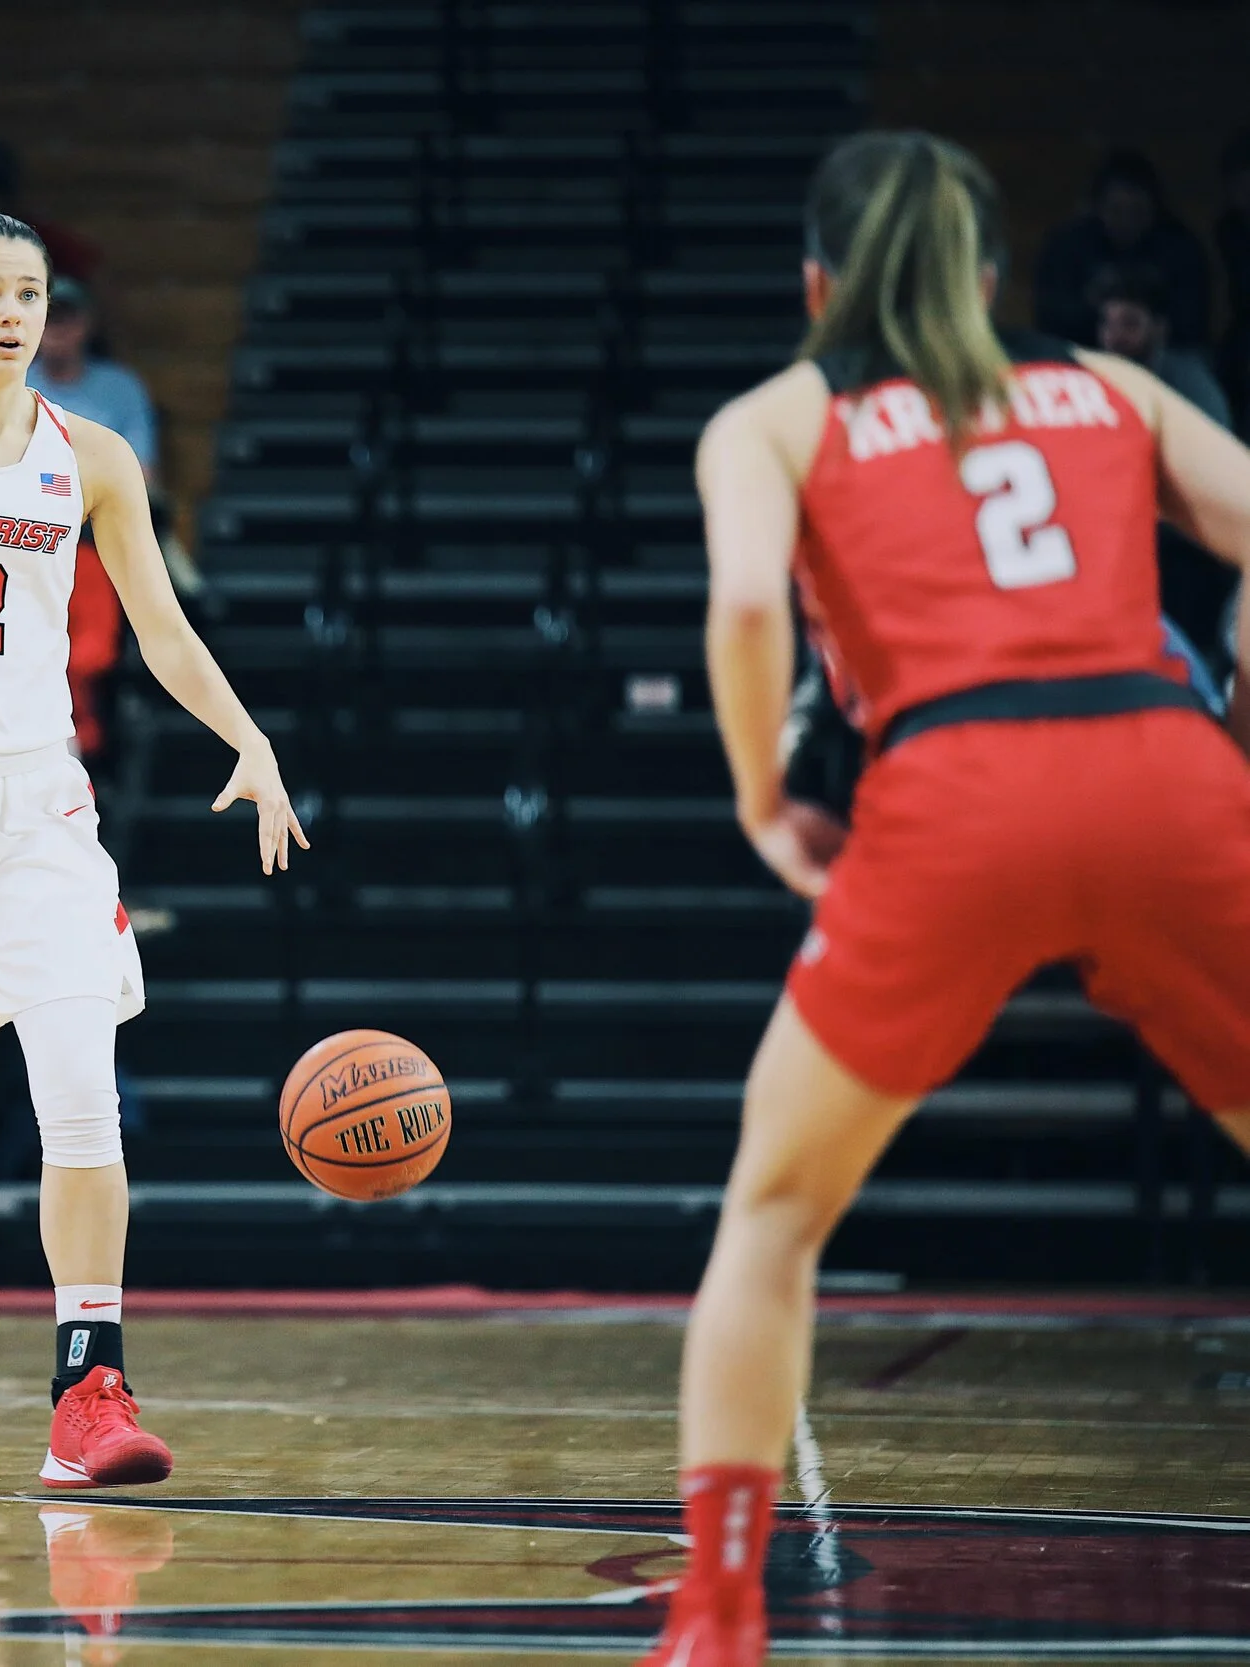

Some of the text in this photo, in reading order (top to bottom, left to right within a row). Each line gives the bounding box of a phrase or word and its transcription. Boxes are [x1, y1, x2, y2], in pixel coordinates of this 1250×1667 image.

[960, 438, 1078, 592] 2
[320, 1057, 427, 1111] MARIST
[334, 1101, 446, 1155] THE ROCK
